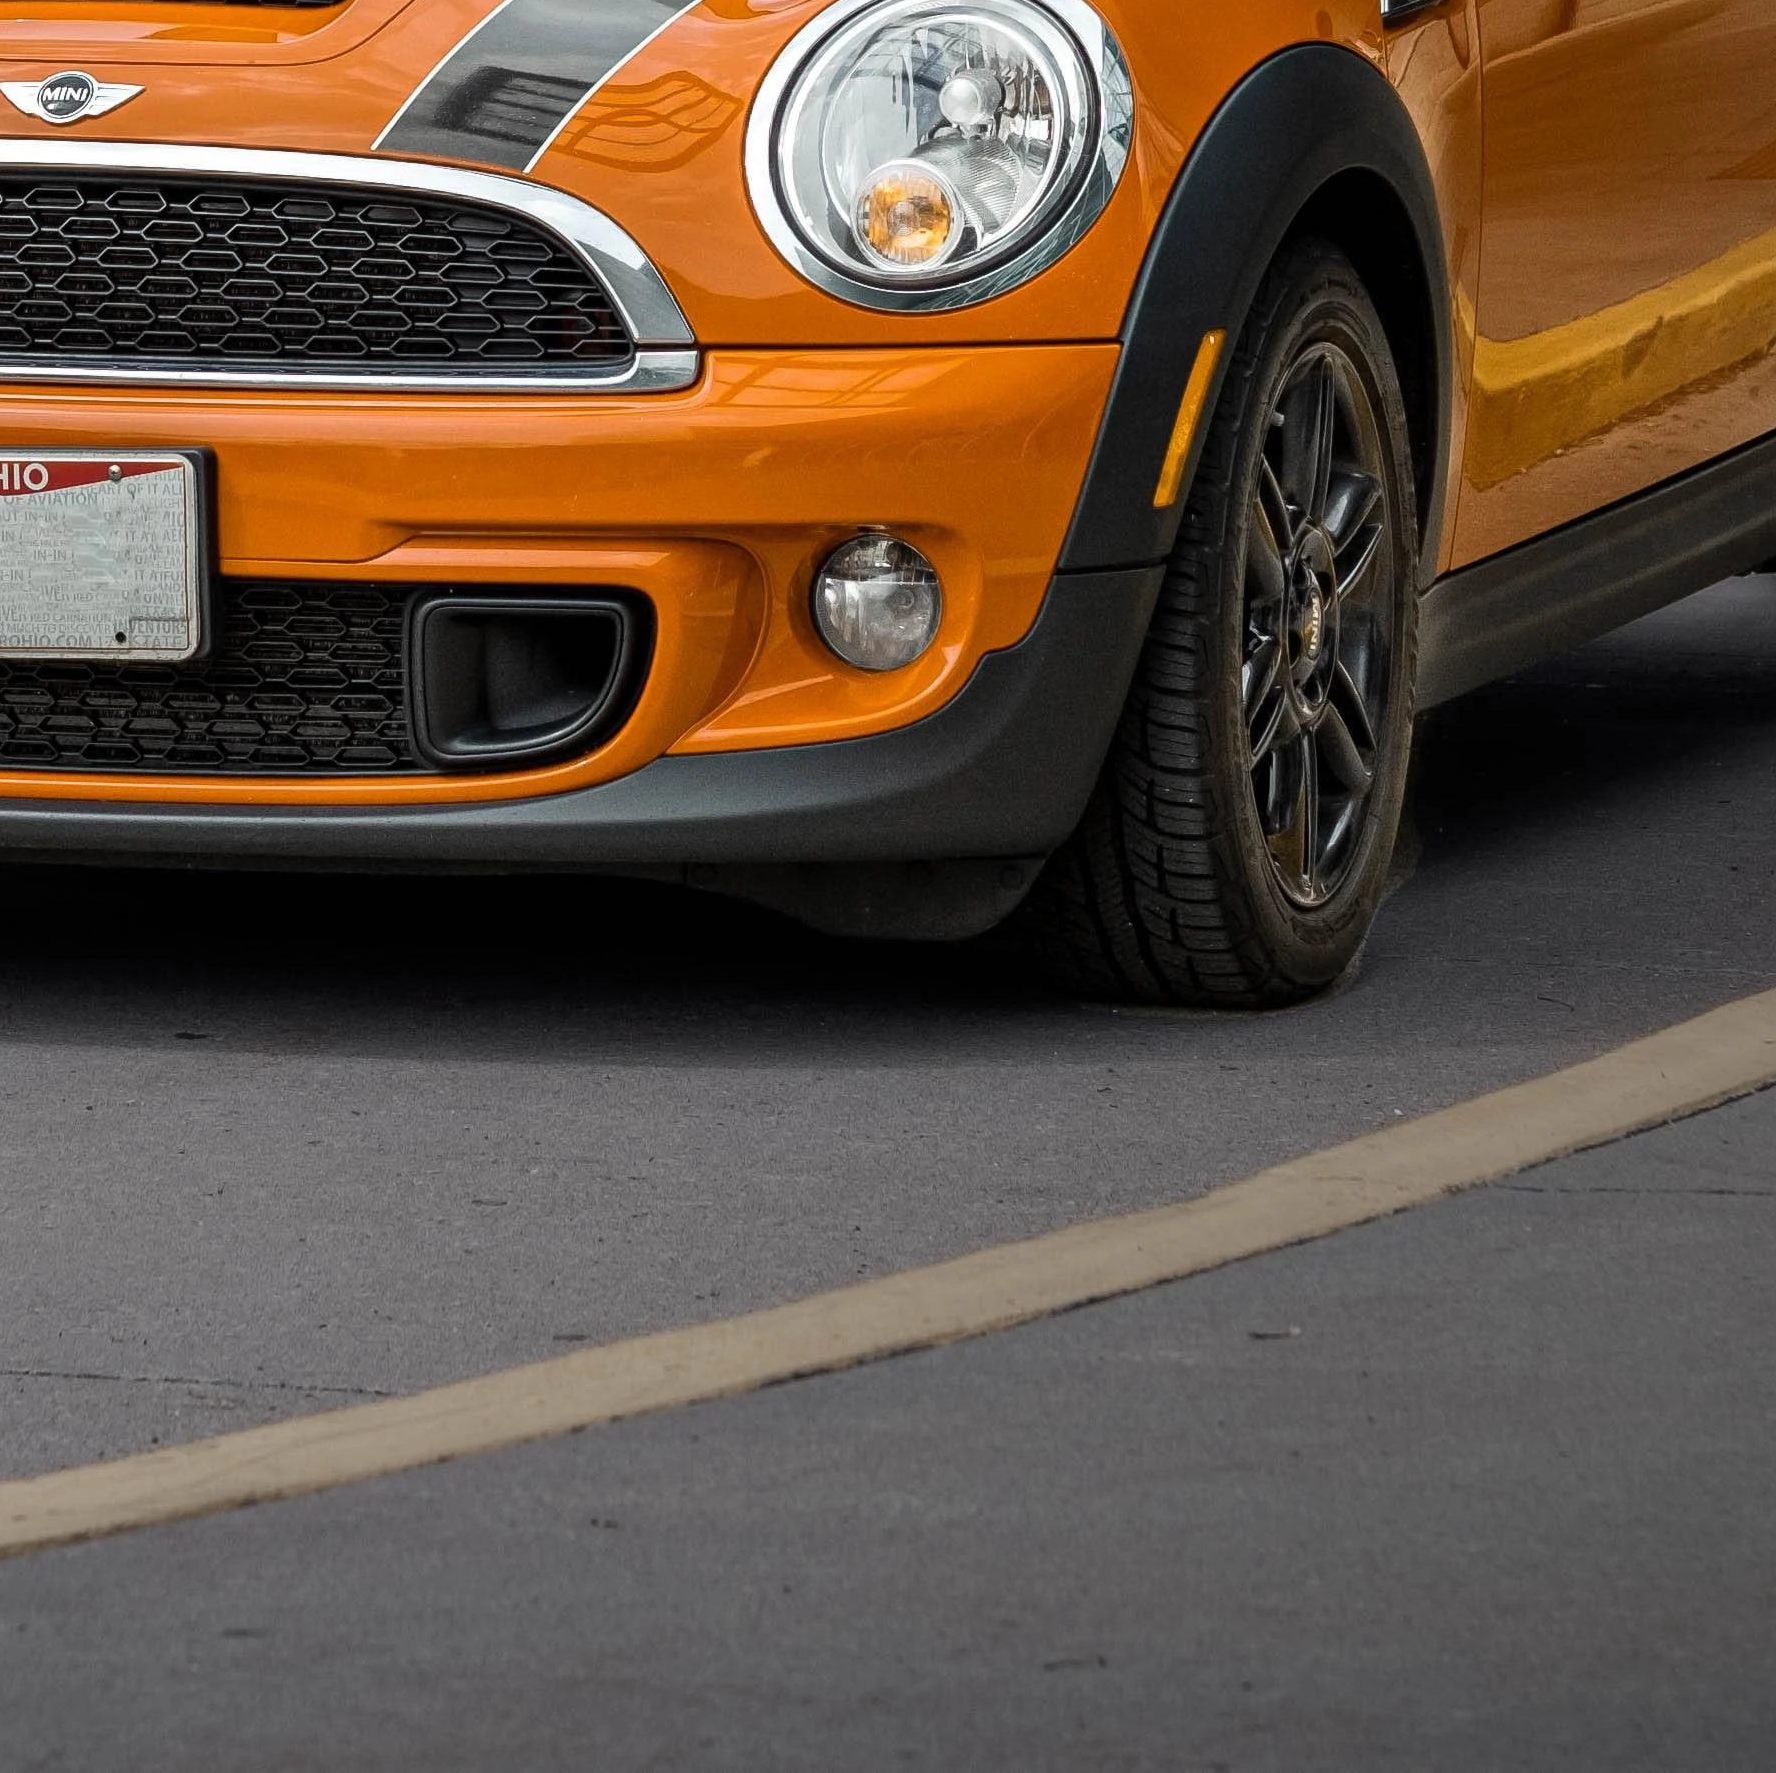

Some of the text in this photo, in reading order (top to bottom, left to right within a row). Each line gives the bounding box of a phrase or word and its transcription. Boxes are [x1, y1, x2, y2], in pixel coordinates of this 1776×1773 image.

[43, 86, 88, 102] MINI
[28, 491, 98, 506] AVIATION
[1310, 597, 1320, 650] MINI
